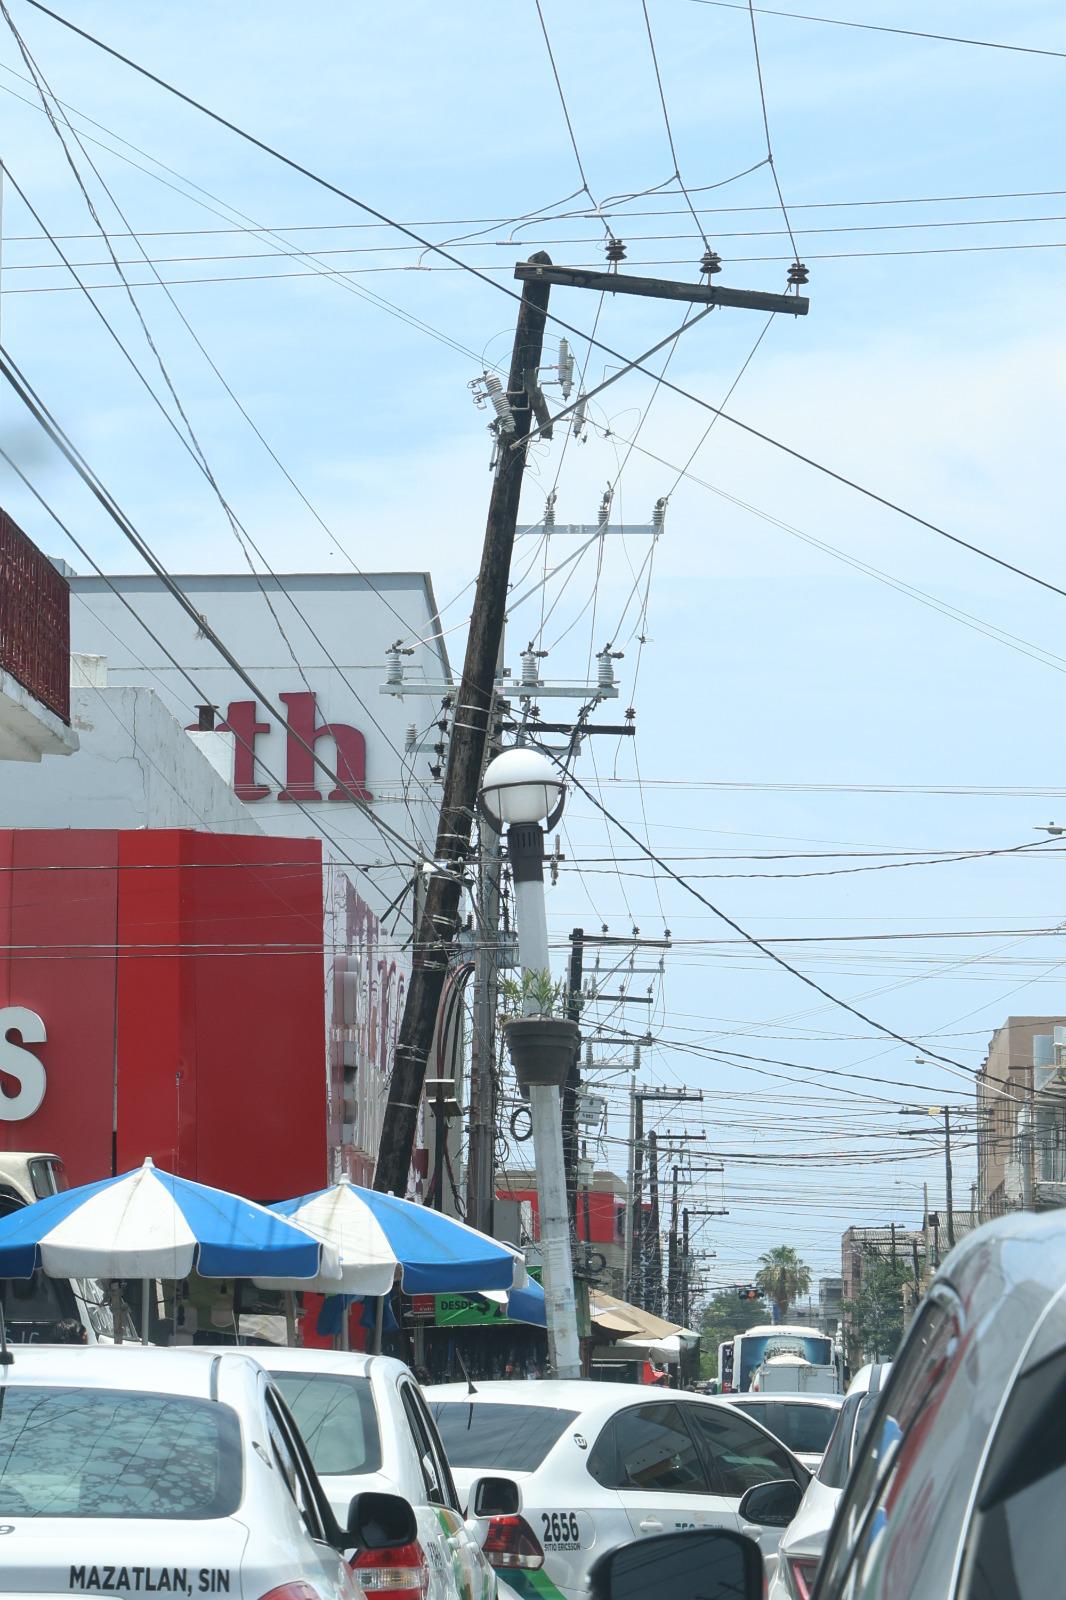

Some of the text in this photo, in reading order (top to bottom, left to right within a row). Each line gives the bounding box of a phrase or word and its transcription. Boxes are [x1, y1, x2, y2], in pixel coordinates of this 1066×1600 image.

[184, 692, 373, 803] th
[441, 1301, 473, 1311] DESDE
[542, 1511, 579, 1542] 2656
[544, 1542, 581, 1551] SITIO ERICSSON
[69, 1565, 230, 1597] MAZATLAN, SIN
